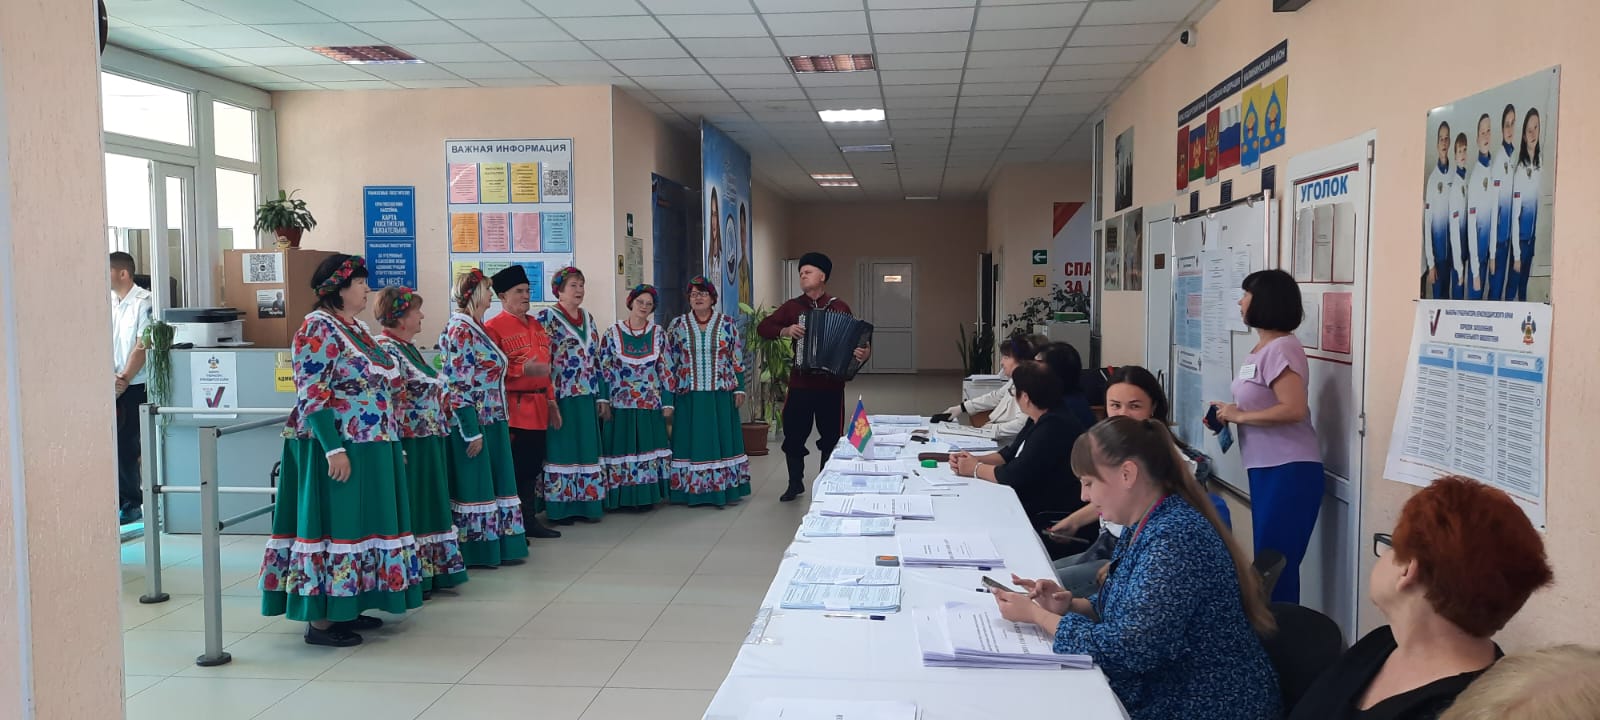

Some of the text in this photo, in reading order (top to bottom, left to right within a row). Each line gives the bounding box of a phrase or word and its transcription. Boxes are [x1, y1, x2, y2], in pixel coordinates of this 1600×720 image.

[451, 144, 567, 153] ВАЖНАЯ ИНФОРМАЦИЯ
[1301, 174, 1348, 203] УГОЛОК
[1065, 262, 1091, 276] СПА
[1064, 280, 1083, 294] ЗА
